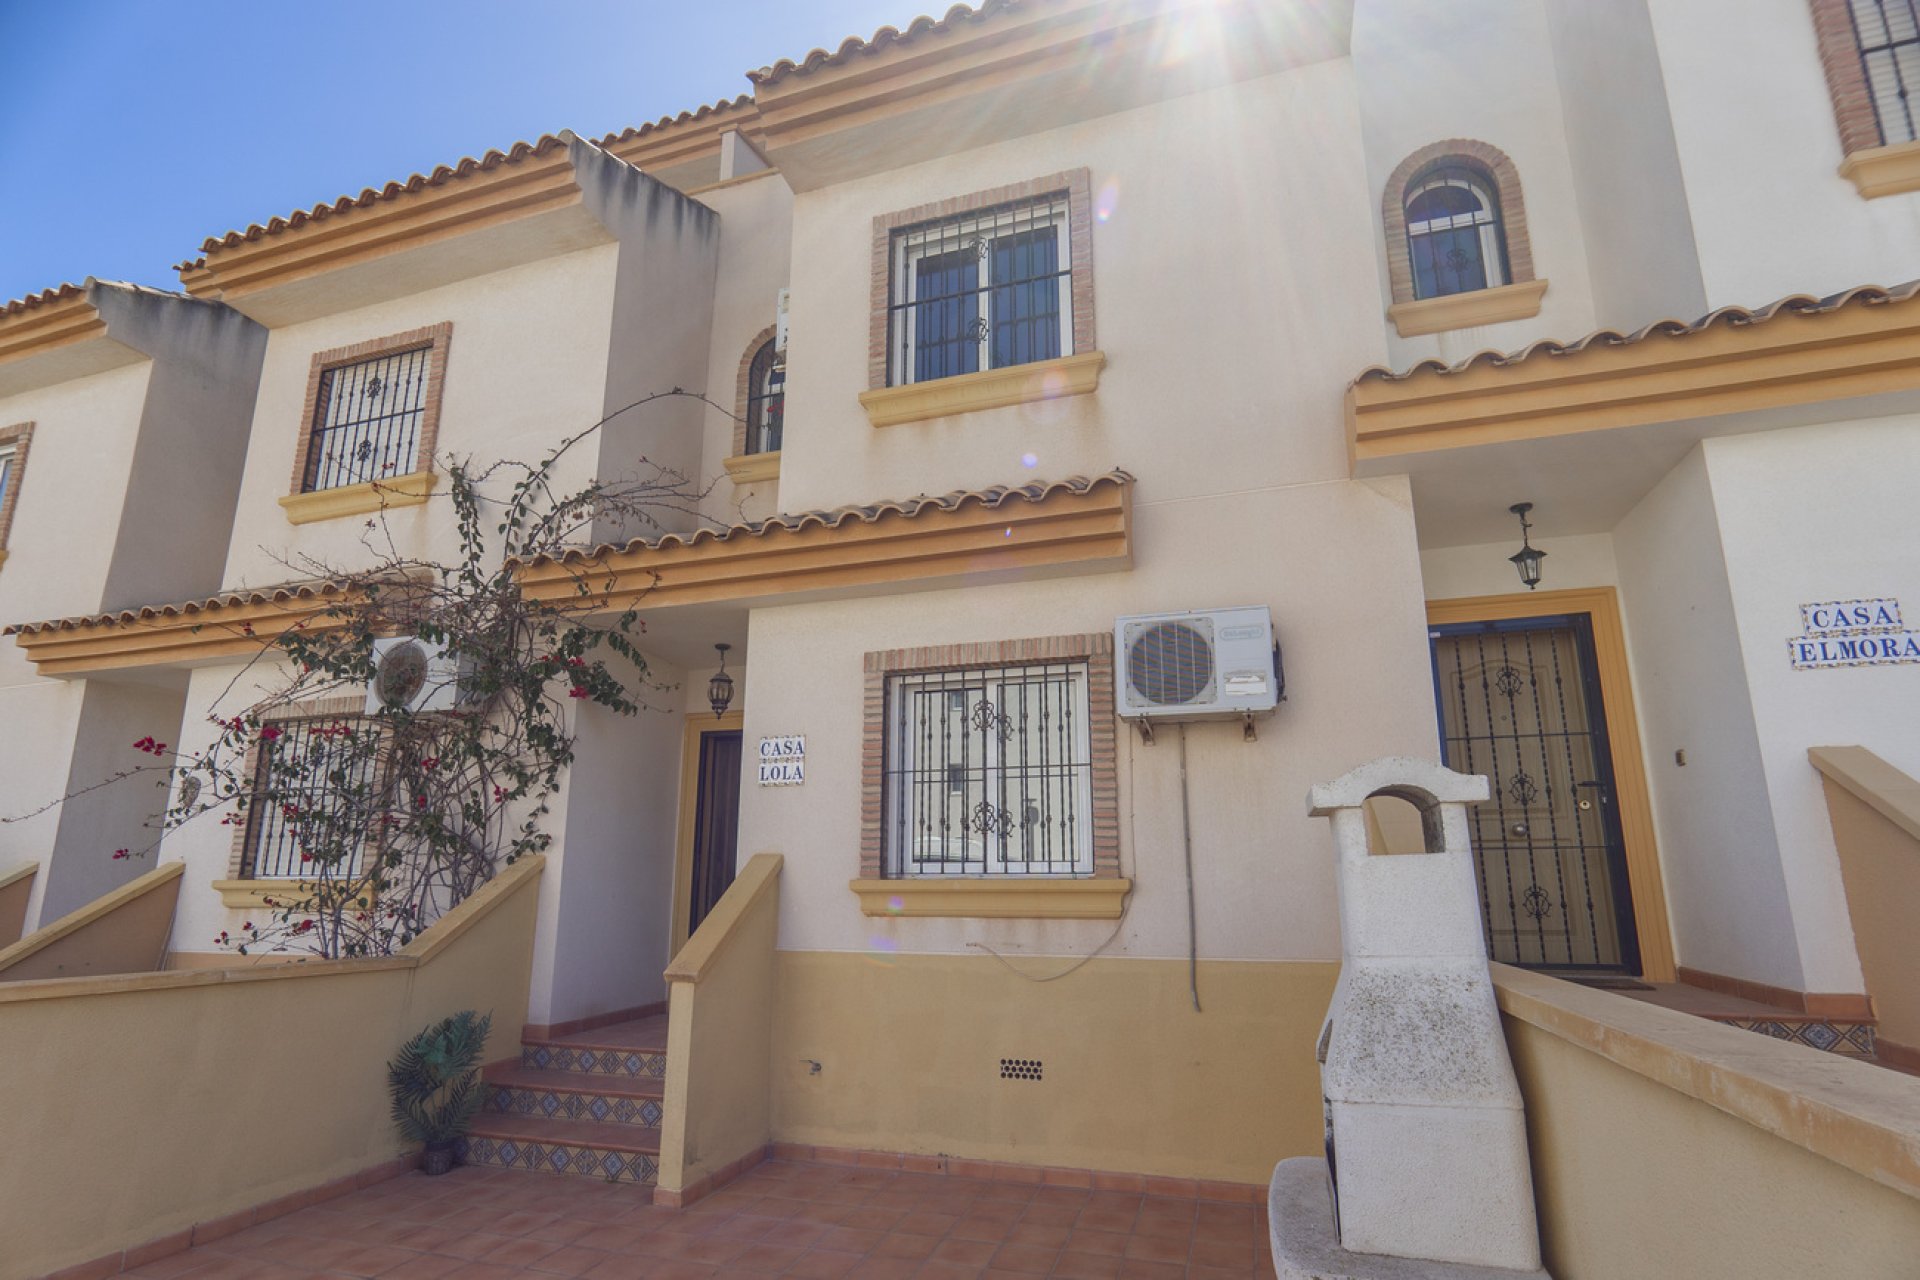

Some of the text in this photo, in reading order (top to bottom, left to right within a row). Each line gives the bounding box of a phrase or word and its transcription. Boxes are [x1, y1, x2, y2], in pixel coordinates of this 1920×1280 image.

[1812, 605, 1895, 628] CASA
[1798, 637, 1920, 662] ELMORA
[760, 740, 804, 756] CASA
[760, 765, 803, 781] LOLA
